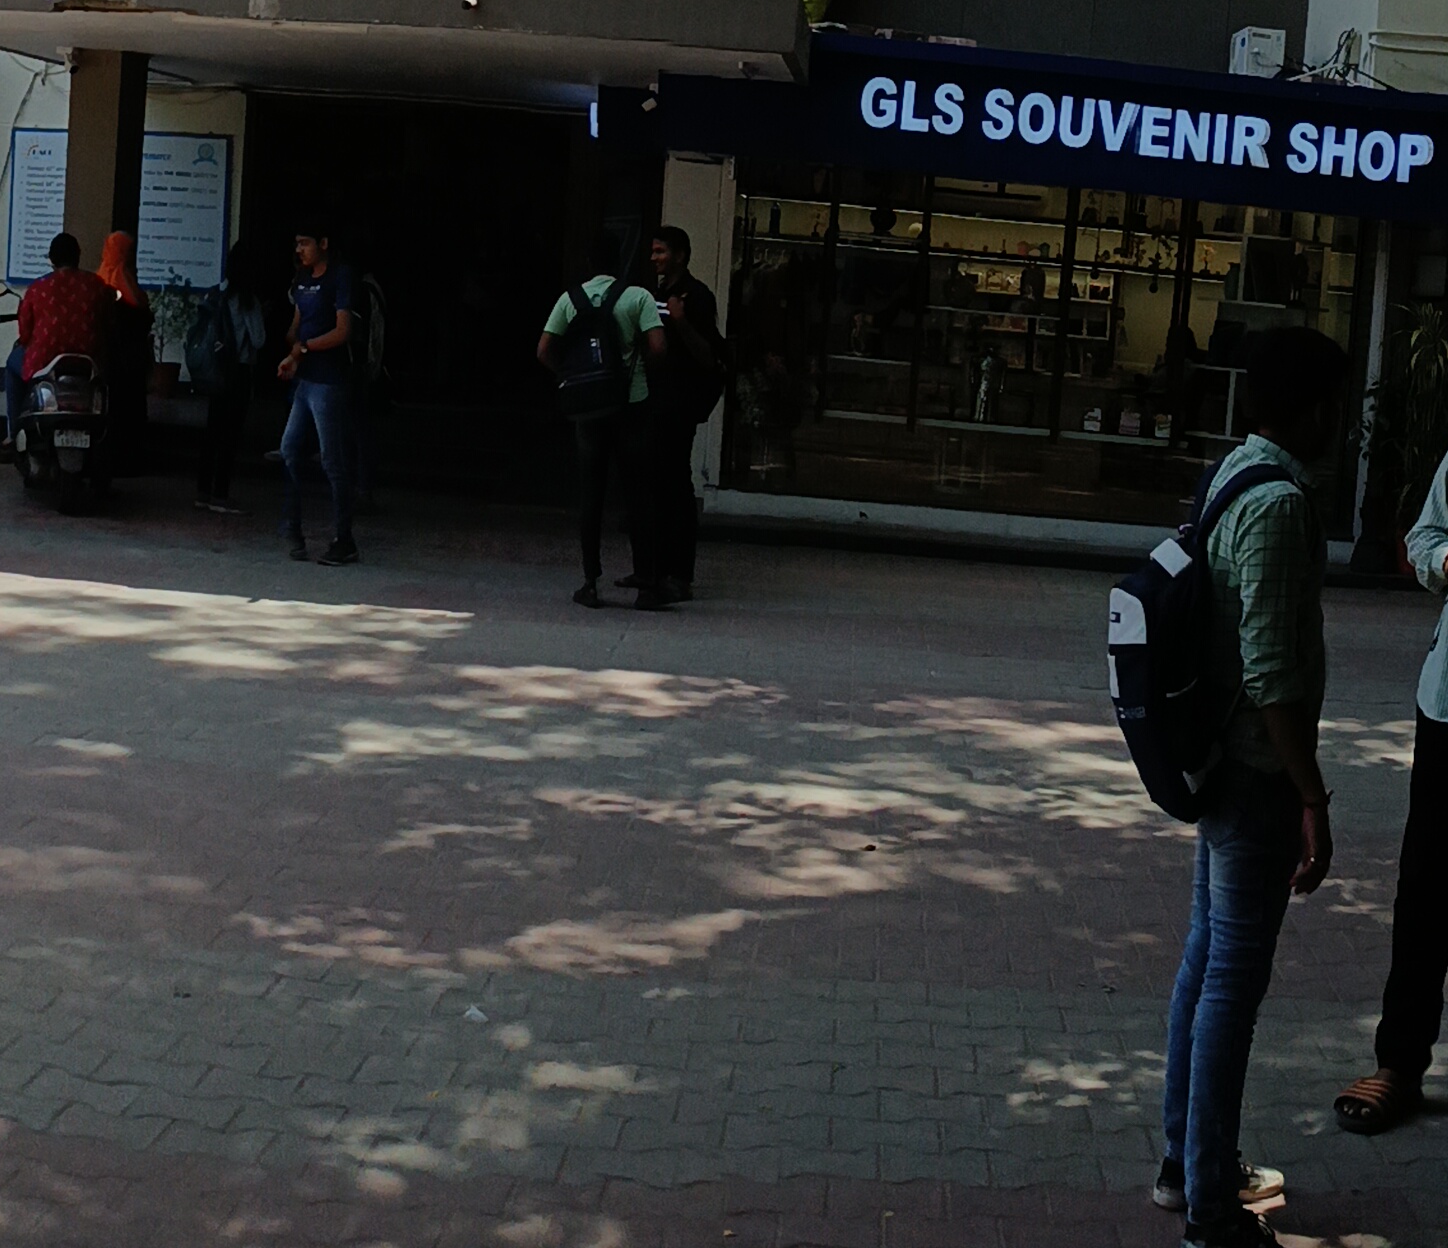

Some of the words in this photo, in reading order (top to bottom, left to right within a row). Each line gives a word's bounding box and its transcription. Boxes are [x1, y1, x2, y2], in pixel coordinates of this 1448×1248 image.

[860, 76, 965, 135] GLS
[981, 87, 1271, 168] SOUVENIR
[1286, 123, 1434, 183] SHOP
